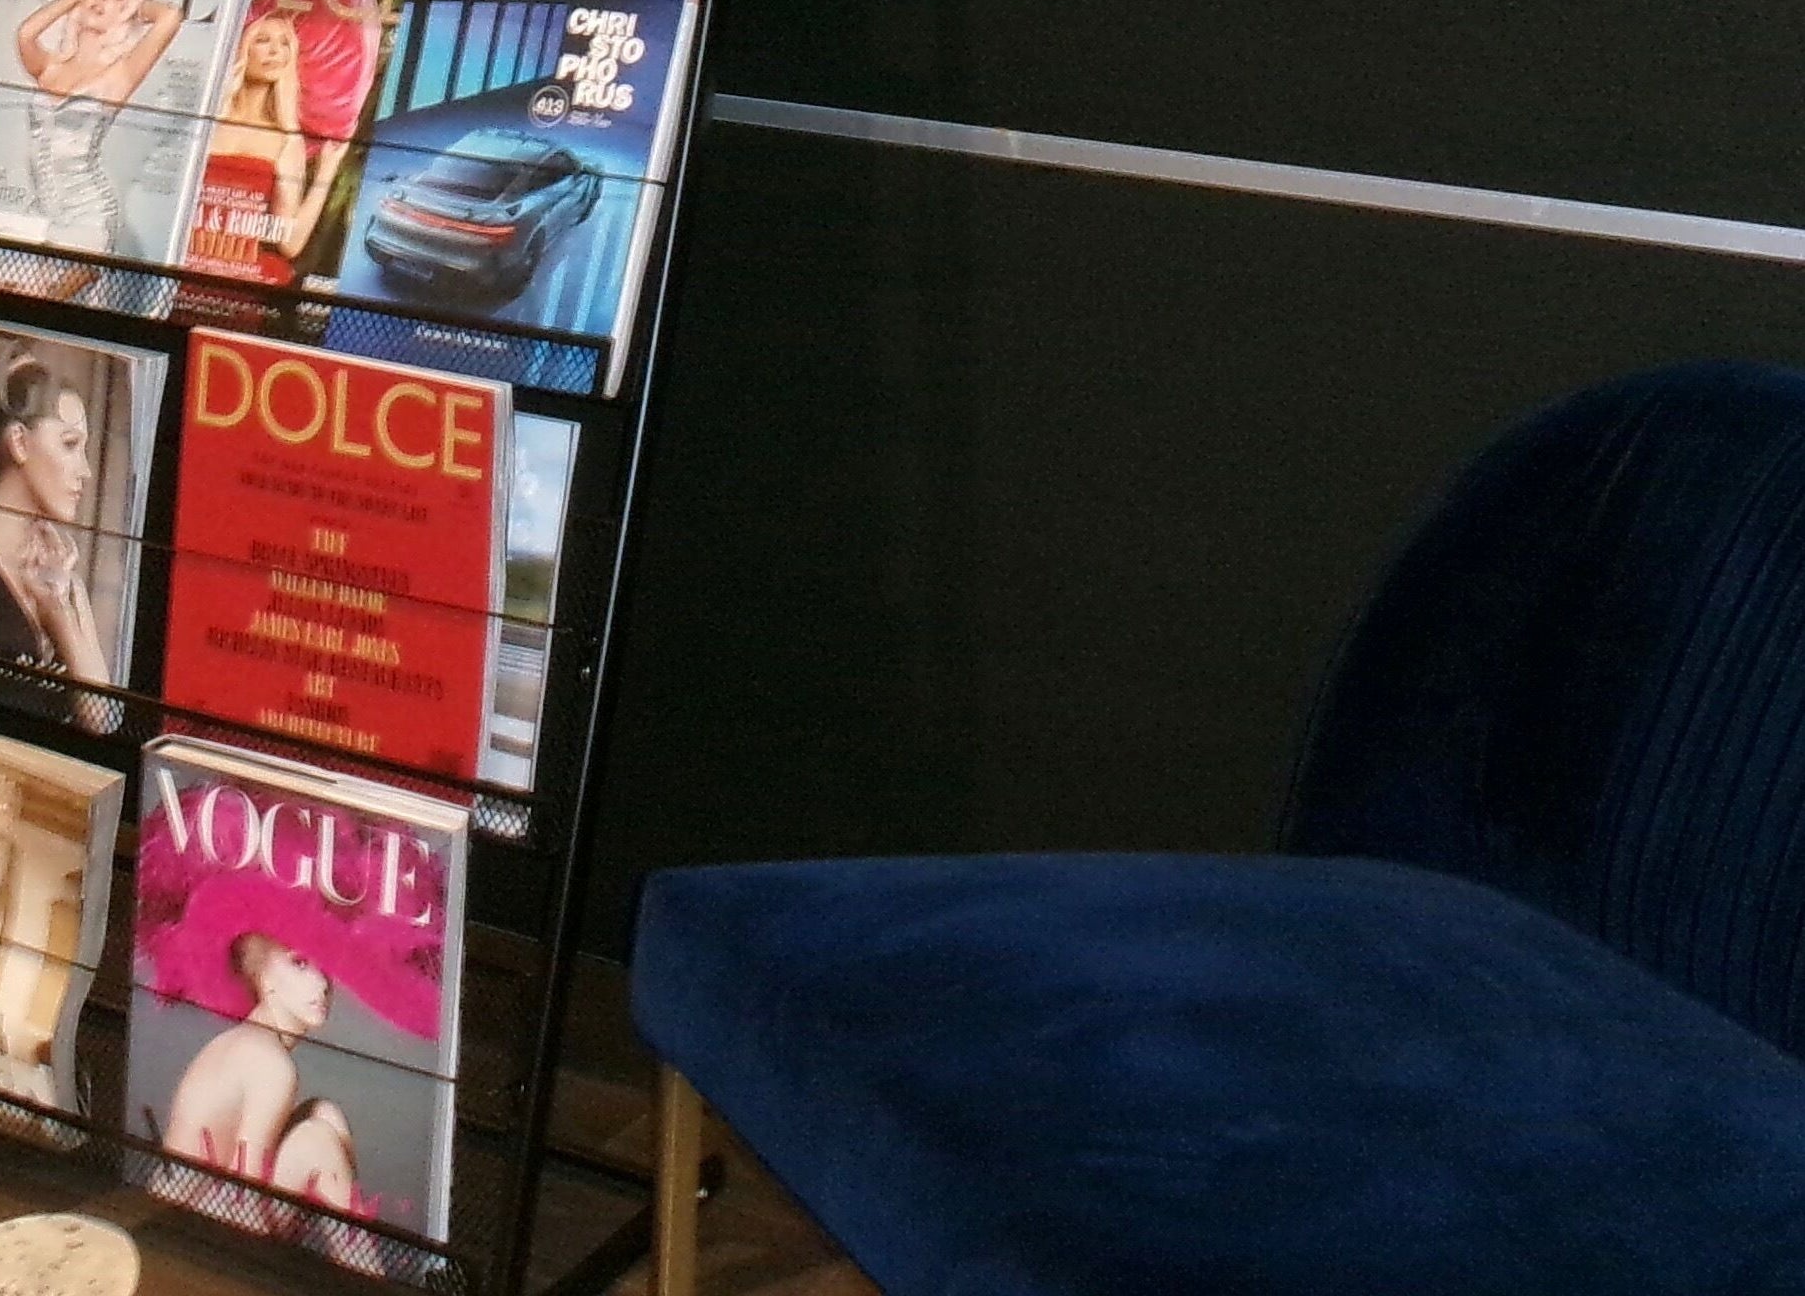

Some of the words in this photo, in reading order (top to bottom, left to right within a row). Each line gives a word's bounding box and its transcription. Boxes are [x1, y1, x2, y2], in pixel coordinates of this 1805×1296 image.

[567, 7, 638, 37] CHRI
[589, 34, 645, 64] STO
[555, 54, 628, 85] PHO
[571, 80, 634, 111] RUS
[196, 343, 483, 480] DOLCE
[154, 767, 432, 928] VOGUE
